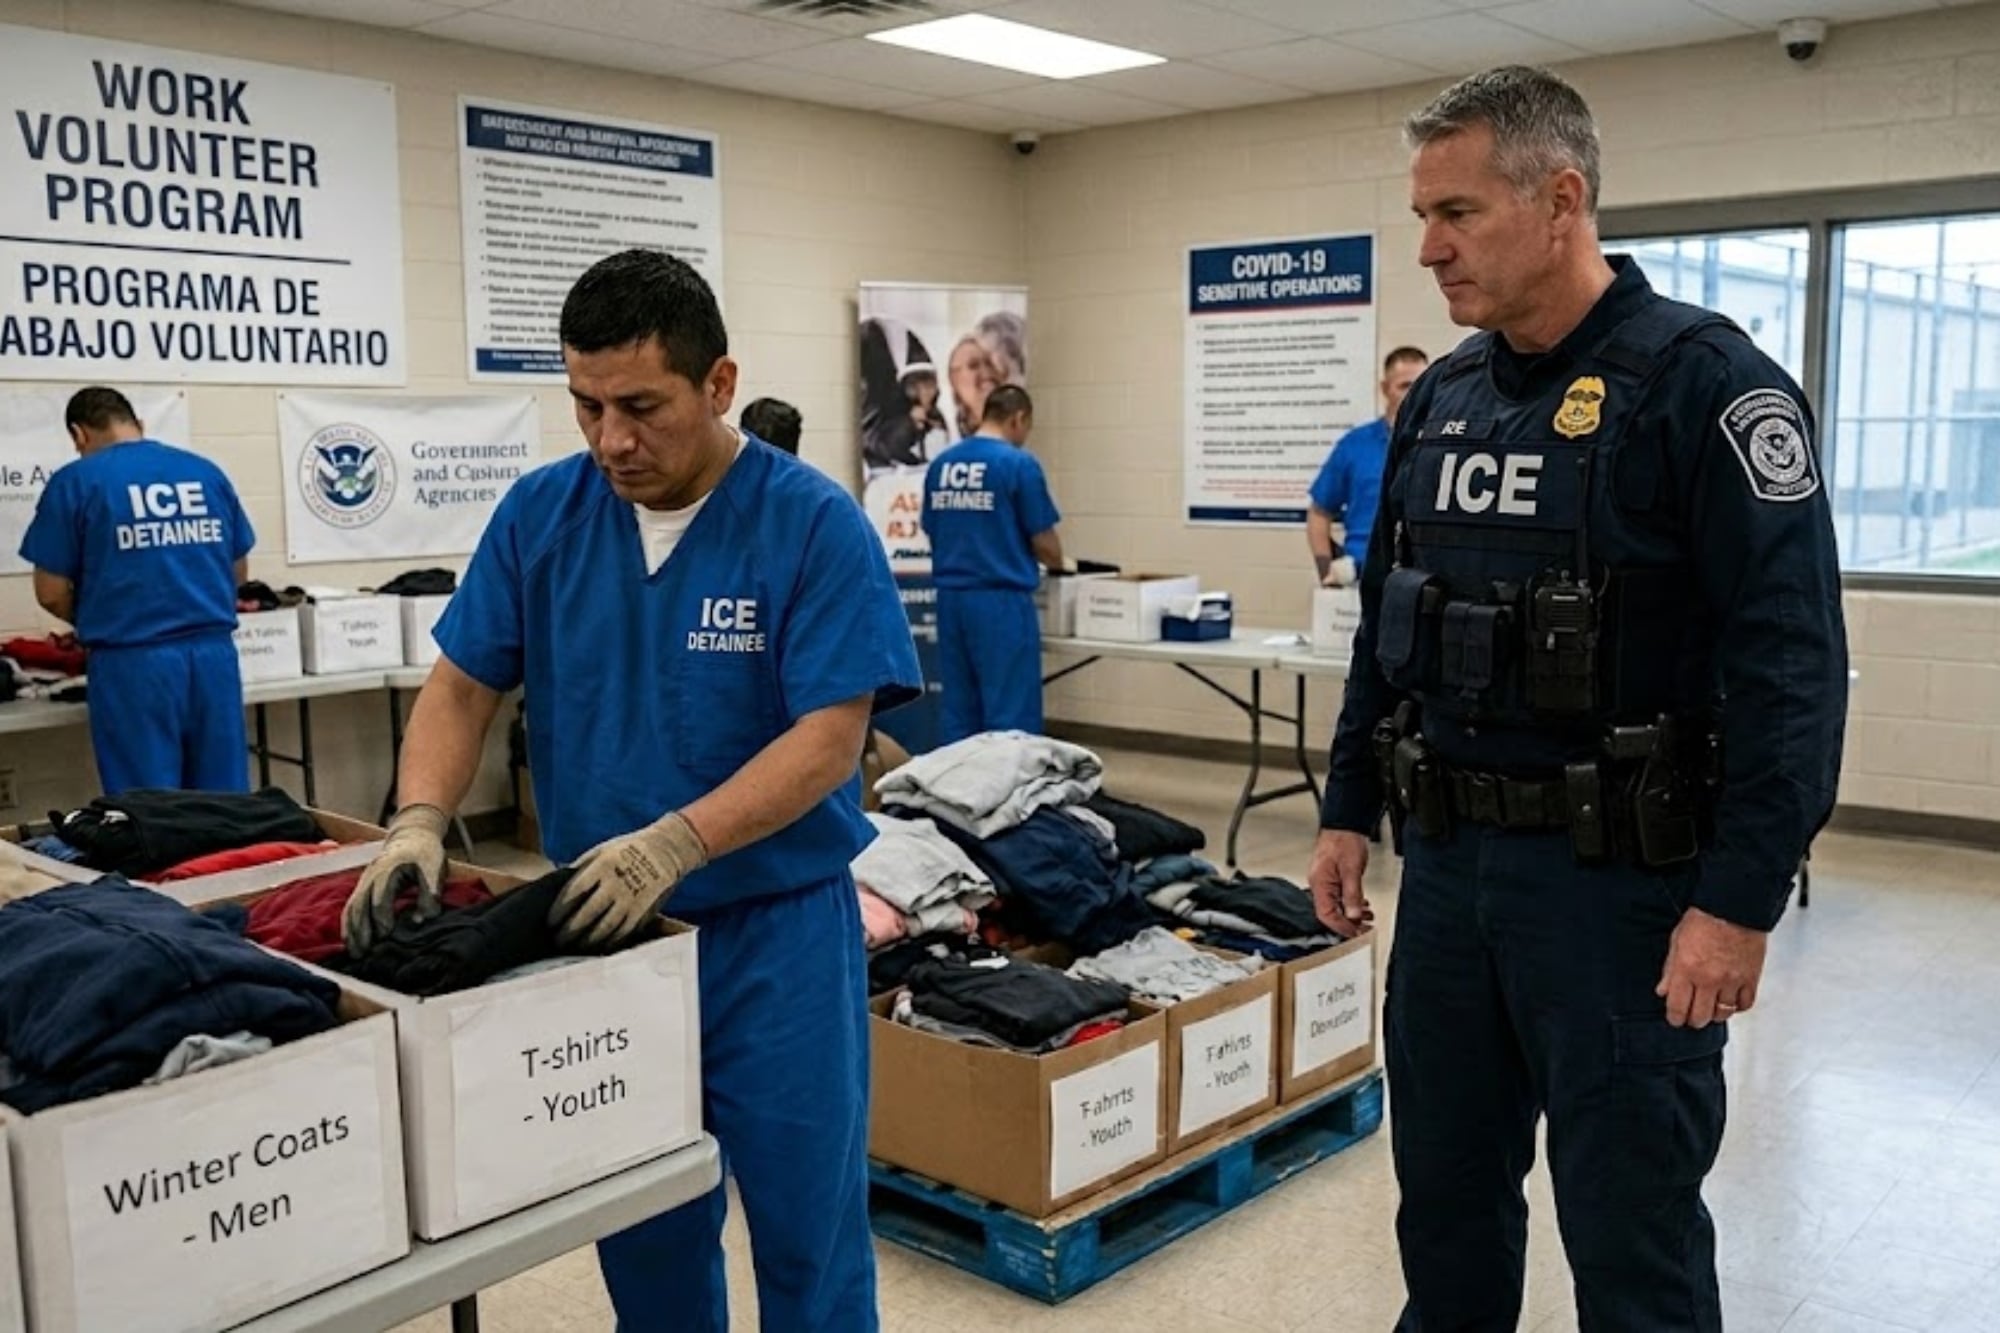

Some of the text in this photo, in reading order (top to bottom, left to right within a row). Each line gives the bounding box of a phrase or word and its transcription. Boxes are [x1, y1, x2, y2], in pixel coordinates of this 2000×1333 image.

[92, 60, 250, 126] WORK
[16, 110, 319, 188] VOLUNTEER
[46, 173, 302, 240] PROGRAM
[1232, 249, 1326, 279] COVID-19
[23, 262, 320, 316] PROGRAMA DE
[1198, 274, 1362, 303] SENSITIVE OPERATIONS
[150, 321, 388, 366] VOLUNTARIO
[413, 464, 448, 482] and
[939, 462, 987, 489] ICE
[1435, 453, 1544, 516] ICE
[128, 481, 208, 519] ICE
[414, 487, 497, 509] Agencies
[116, 519, 223, 550] DETAINEE
[701, 598, 757, 630] ICE
[687, 631, 765, 652] DETAINEE
[521, 1026, 629, 1078] T-shirts
[543, 1075, 627, 1122] Youth
[103, 1114, 350, 1215] Winter Coats
[209, 1193, 292, 1243] Men
